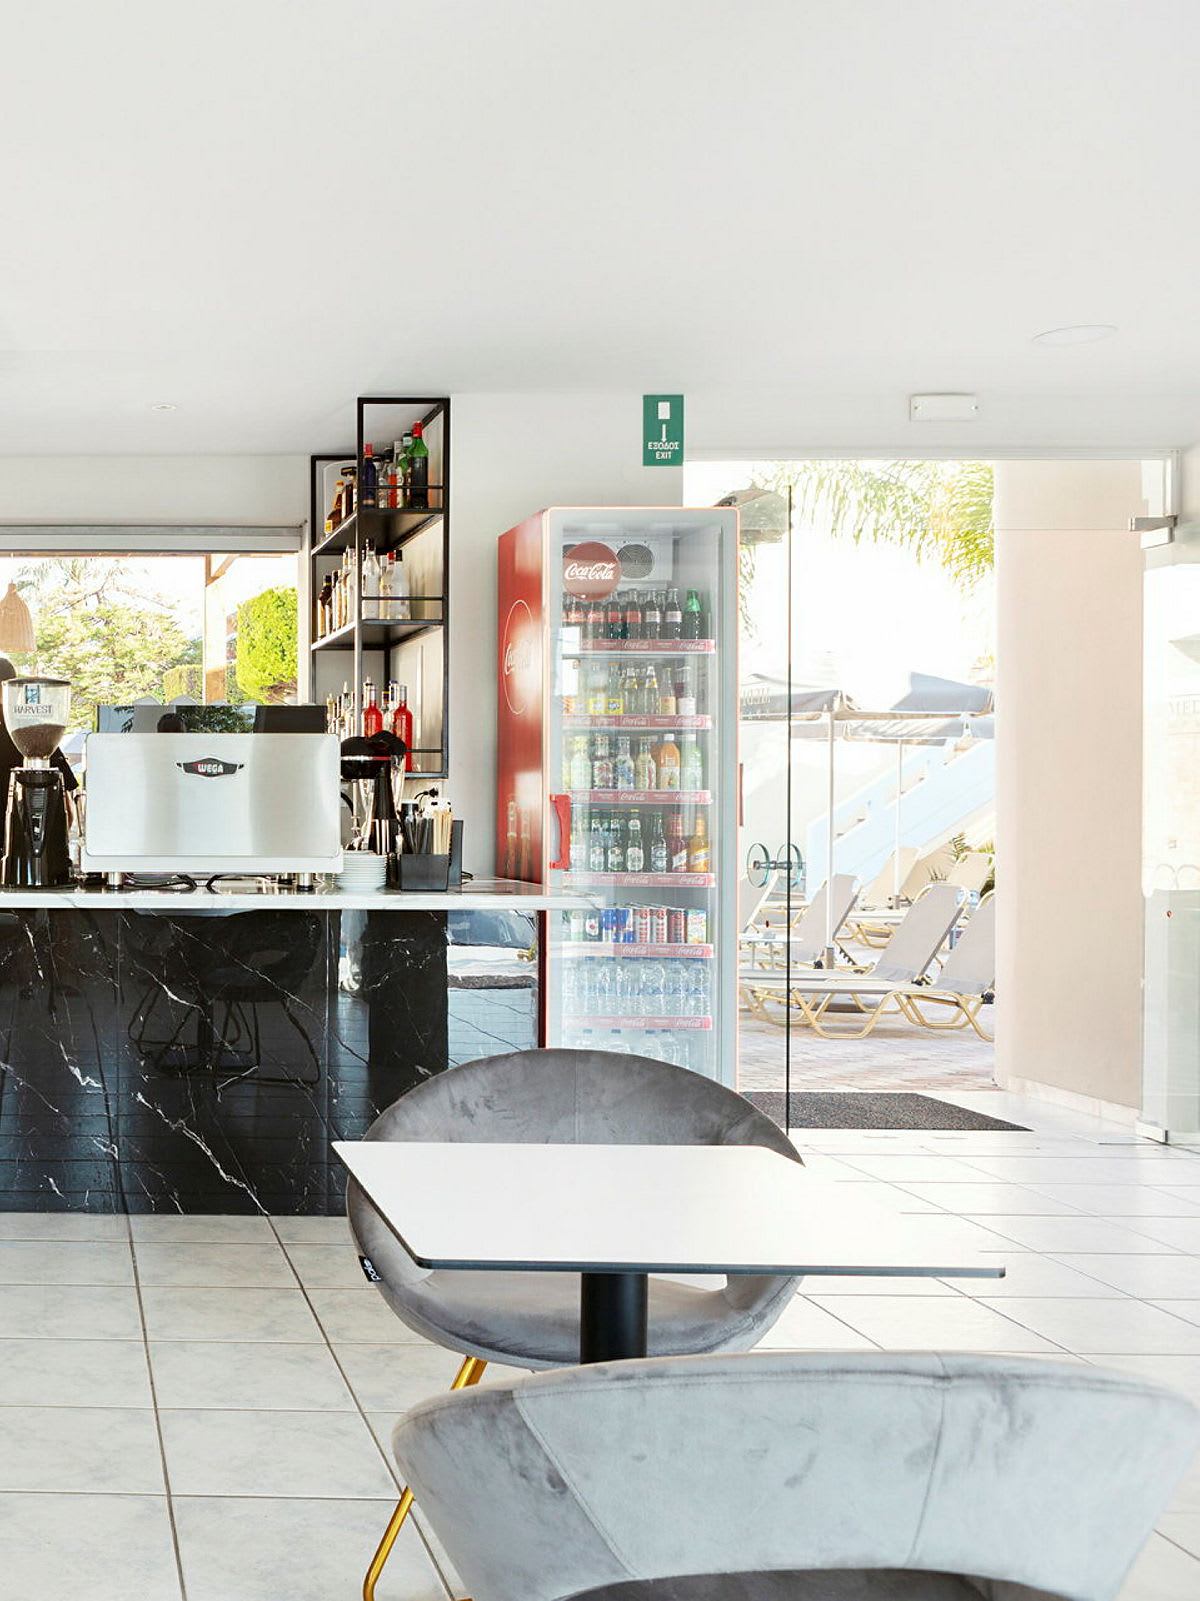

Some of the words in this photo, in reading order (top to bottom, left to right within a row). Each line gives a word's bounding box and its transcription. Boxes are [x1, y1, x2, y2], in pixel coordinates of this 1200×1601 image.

[655, 451, 672, 460] EXIT
[564, 562, 616, 580] Coca-Cola
[13, 704, 53, 714] HARVEST
[197, 763, 224, 774] WEGA
